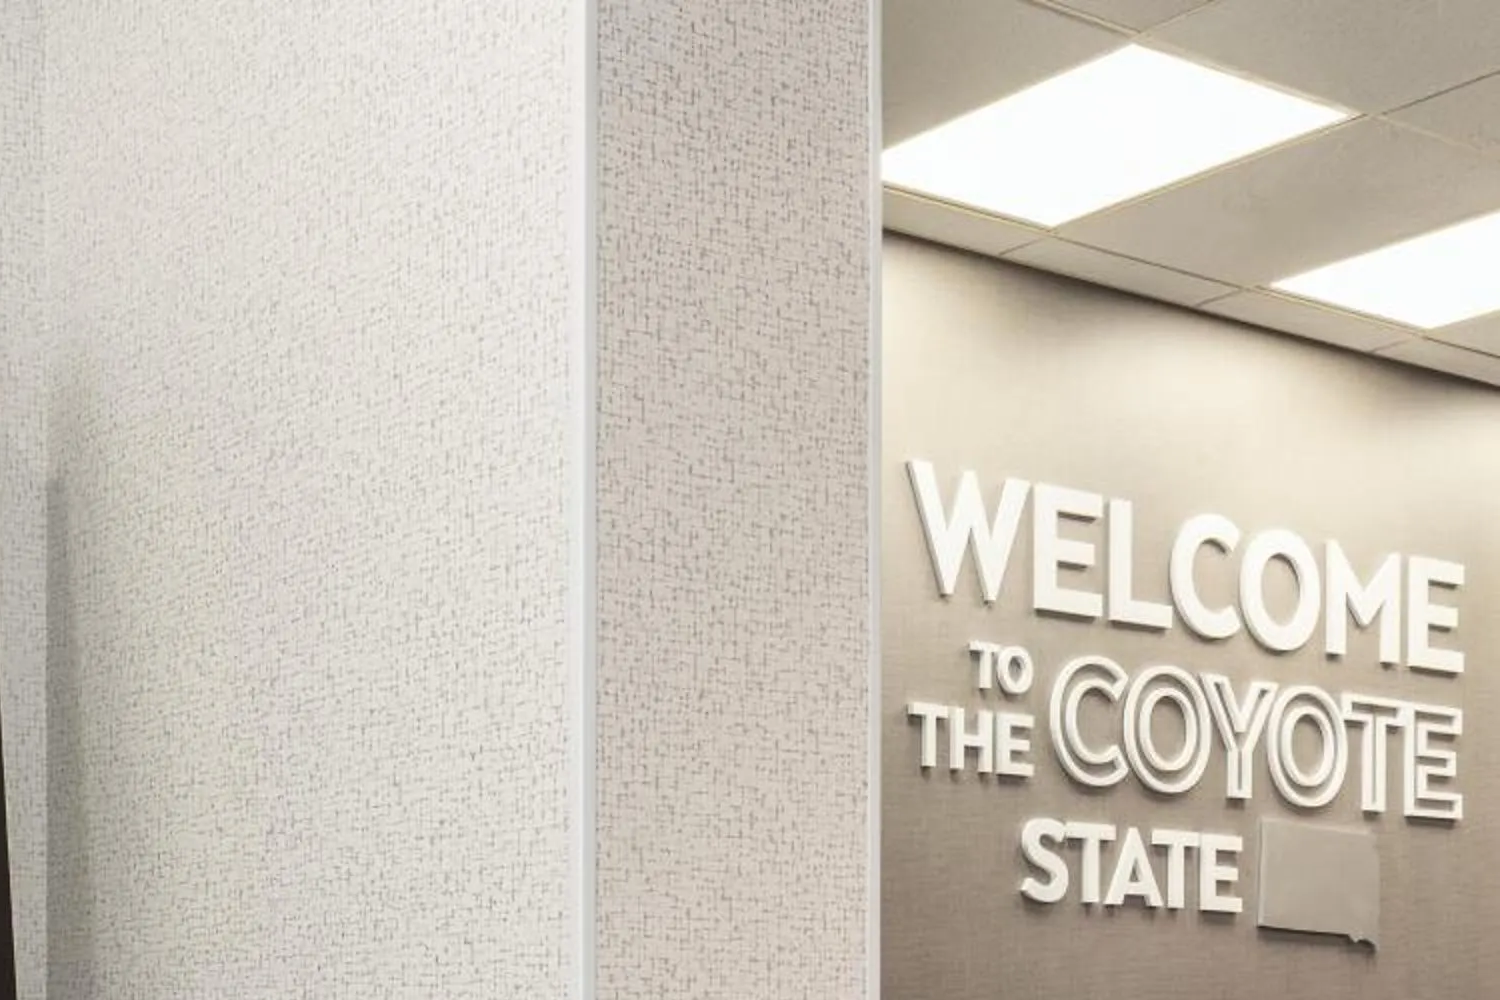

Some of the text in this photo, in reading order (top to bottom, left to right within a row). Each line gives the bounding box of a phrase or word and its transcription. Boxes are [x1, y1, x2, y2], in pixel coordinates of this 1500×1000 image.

[905, 459, 1466, 676] WELCOME
[968, 639, 1034, 696] TO
[906, 655, 1464, 822] THE COYOTE
[1019, 817, 1245, 914] STATE
